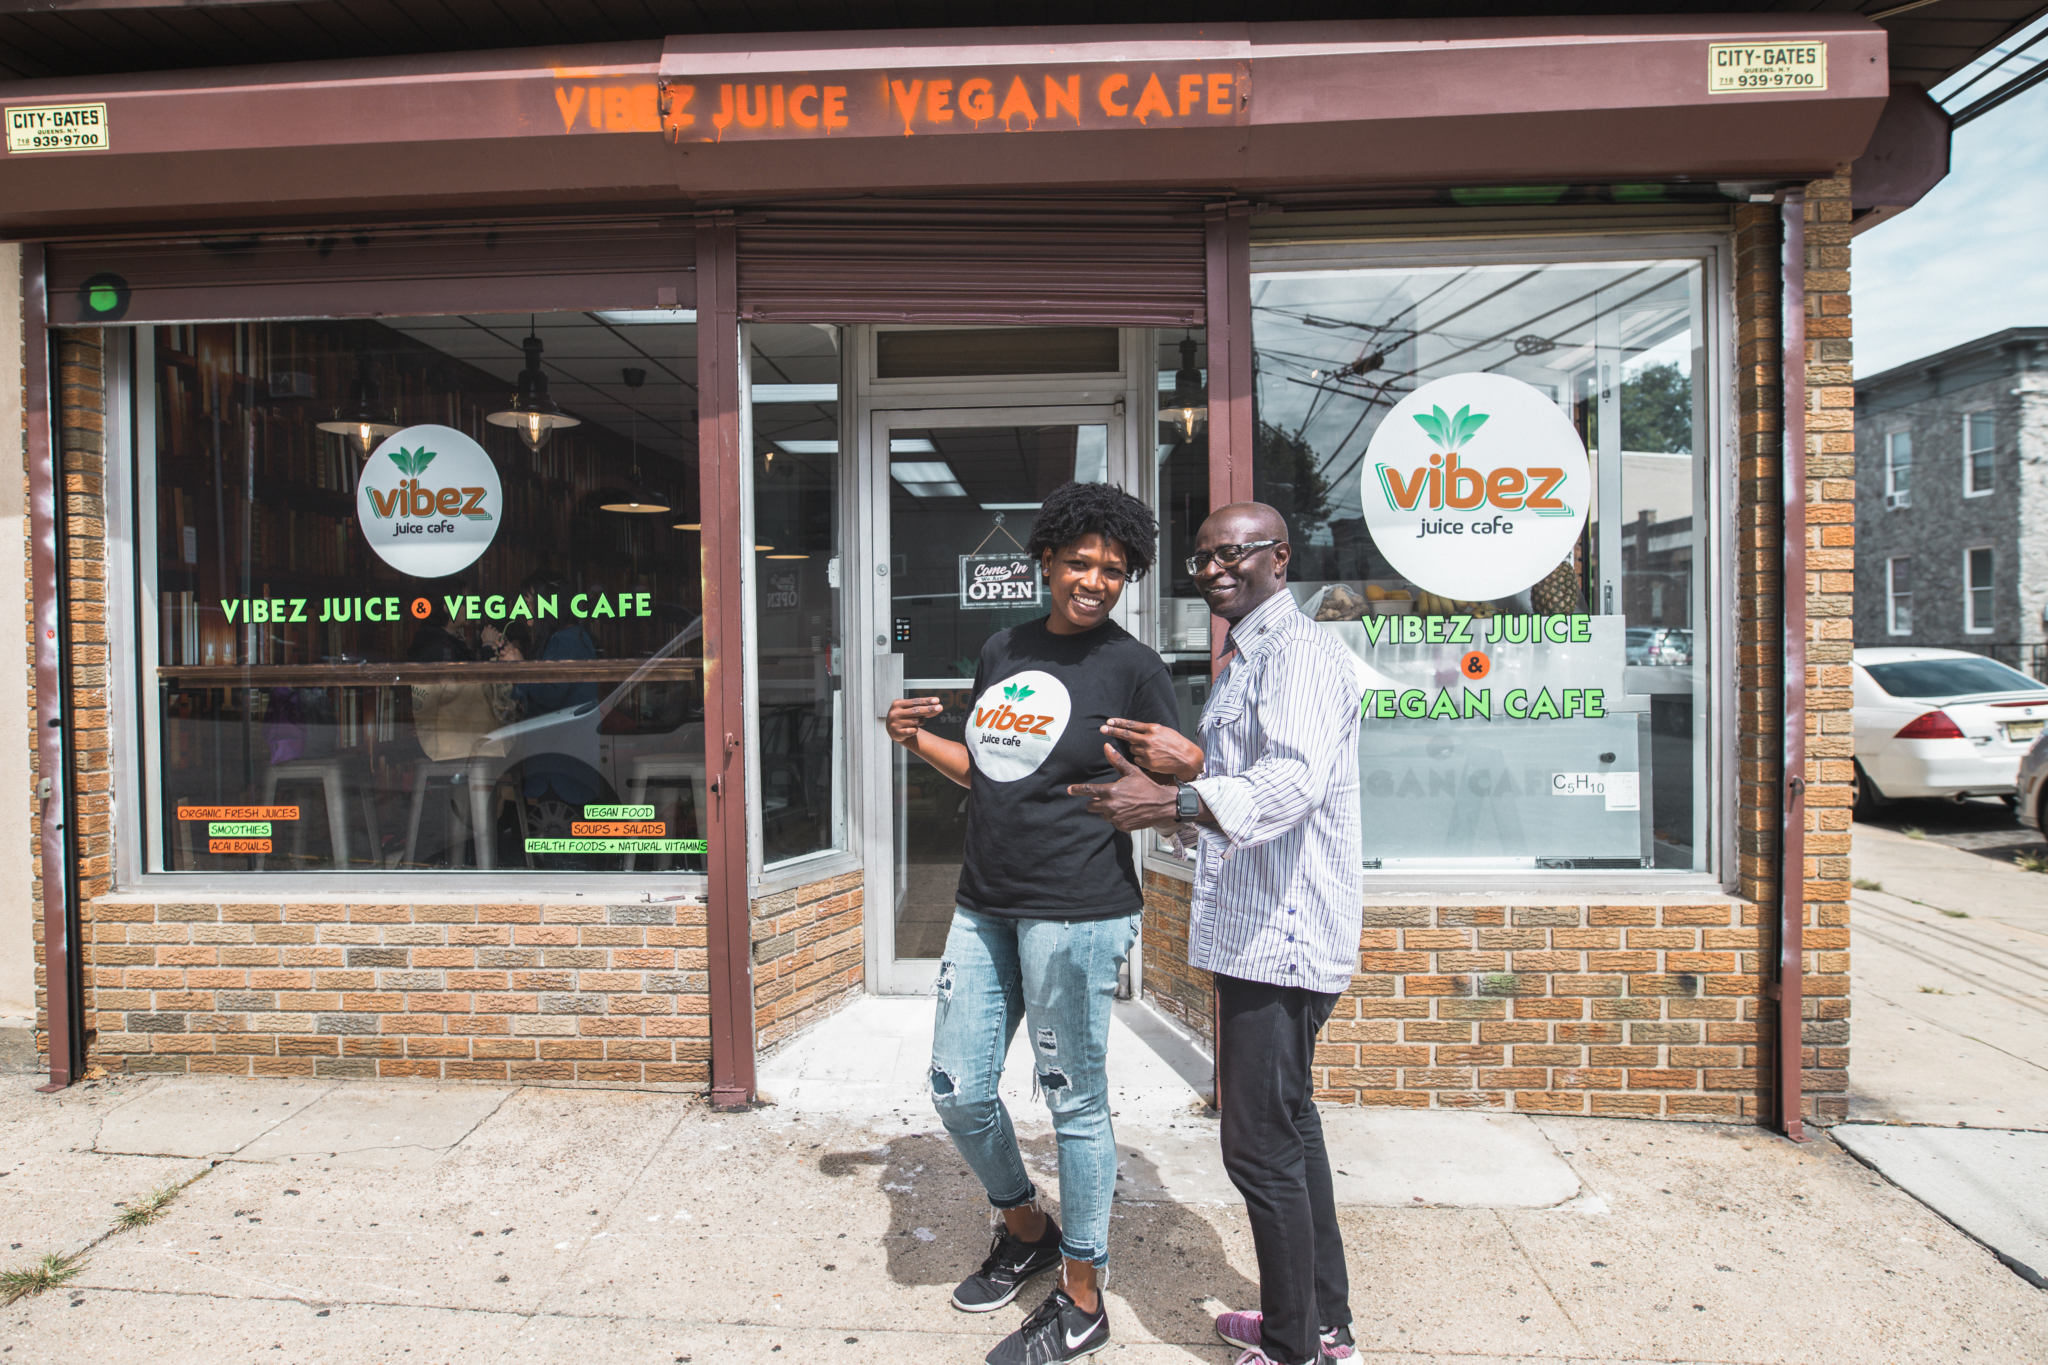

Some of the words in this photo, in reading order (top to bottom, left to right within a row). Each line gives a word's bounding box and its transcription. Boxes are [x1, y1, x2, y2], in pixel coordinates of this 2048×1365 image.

[1717, 47, 1816, 67] CITY-GATES
[712, 84, 849, 134] JUICE
[890, 74, 1080, 131] VEGAN
[1099, 72, 1233, 124] CAFE
[13, 109, 99, 128] CITY-GATES
[1375, 452, 1575, 518] vibez
[366, 478, 493, 520] vibez
[392, 522, 424, 537] juice
[427, 519, 455, 534] cafe
[1416, 518, 1464, 539] juice
[1471, 516, 1514, 535] cafe
[974, 563, 1007, 577] Come
[1010, 561, 1029, 575] In
[968, 581, 1034, 600] OPEN
[220, 598, 308, 624] VIBEZ
[319, 597, 401, 622] JUICE
[444, 593, 559, 622] VEGAN
[570, 592, 652, 619] CAFE
[1361, 613, 1474, 648] VIBEZ
[1485, 613, 1593, 644] JUICE
[1503, 686, 1606, 720] CAFE
[973, 704, 1055, 742] vibez
[980, 733, 1000, 745] juice
[1002, 735, 1021, 747] cafe
[180, 809, 221, 818] ORGANIC
[225, 809, 259, 818] FRESH
[262, 808, 297, 818] JUICES
[586, 808, 618, 818] VEGAN
[621, 808, 653, 818] FOOD
[211, 825, 270, 834] SMOOTHIES
[574, 825, 610, 834] SOUPS
[623, 825, 664, 834] SALADS
[211, 842, 231, 851] ACAI
[234, 841, 270, 851] BOWLS
[527, 842, 565, 850] HEALTH
[568, 842, 606, 850] FOODS
[619, 842, 661, 850] NATURAL
[664, 842, 708, 852] VITAMINS
